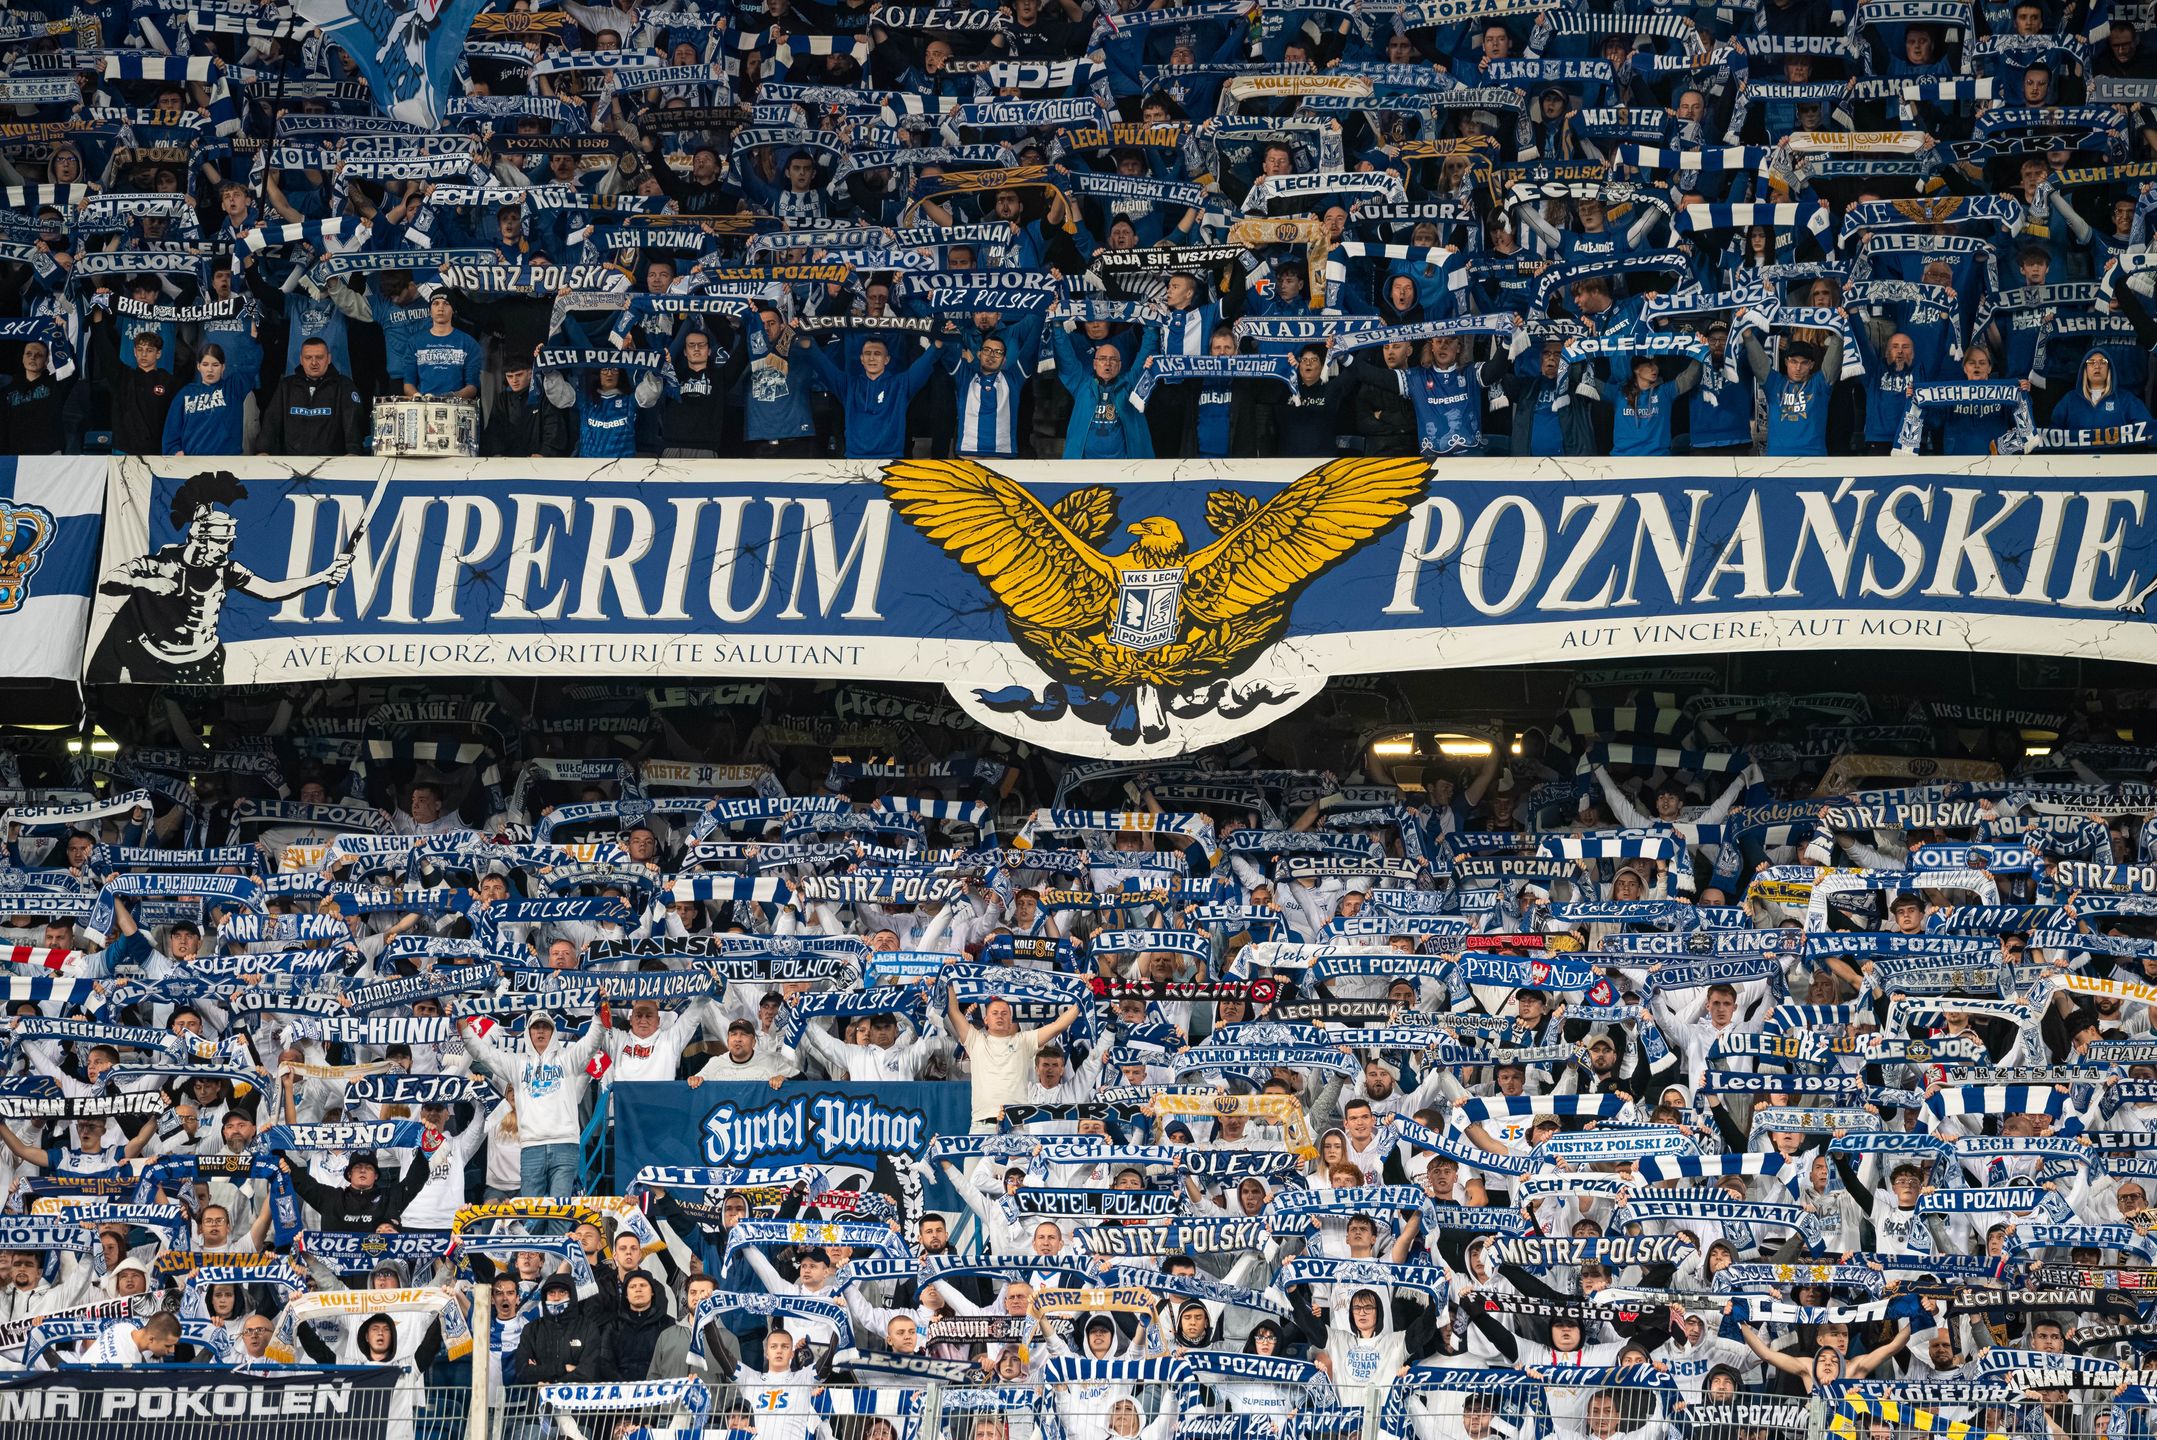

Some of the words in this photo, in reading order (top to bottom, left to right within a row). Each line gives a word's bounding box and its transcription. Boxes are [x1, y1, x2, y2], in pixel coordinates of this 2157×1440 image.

[1746, 34, 1850, 56] KOLEJORZ
[552, 48, 645, 67] LECH
[620, 66, 710, 86] BUŁGARSKA
[2102, 84, 2148, 98] LECH
[1583, 107, 1663, 126] MAJSTER
[1980, 107, 2031, 126] LECH
[1951, 133, 2089, 159] PYRY
[1555, 166, 1604, 181] POLSKI
[1275, 175, 1321, 192] LECH
[1353, 203, 1471, 220] KOLEJORZ
[1842, 205, 1891, 231] AVE
[1968, 197, 2021, 220] KKS
[606, 230, 640, 250] LECH
[77, 253, 198, 273] KOLEJORZ
[1104, 254, 1142, 267] BOJĄ
[1147, 253, 1171, 266] SIĘ
[1178, 248, 1246, 263] WSZYSCY
[1567, 260, 1618, 278] JEST
[1624, 254, 1687, 269] SUPER
[440, 266, 521, 290] MISTRZ
[531, 265, 607, 289] POLSKI
[719, 267, 764, 280] LECH
[908, 272, 1055, 292] KOLEJORZ
[652, 298, 749, 317] KOLEJORZ
[974, 290, 1043, 308] POLSKI
[800, 316, 845, 331] LECH
[1567, 336, 1702, 357] KOLEJORZ
[536, 350, 578, 367] LECH
[1156, 358, 1185, 372] KKS
[1190, 358, 1222, 370] Lech
[1228, 357, 1278, 372] Poznań
[1428, 393, 1470, 404] SUPERBET
[587, 418, 629, 428] SUPERBET
[1382, 479, 2148, 615] POZNAŃSKIE
[269, 494, 893, 623] IMPERIUM
[1127, 573, 1147, 583] KKS
[1153, 572, 1178, 583] LECH
[1122, 629, 1167, 643] POZNAŃ
[1561, 628, 1621, 648] AUT
[1633, 620, 1769, 644] VINCERE,
[1788, 618, 1850, 637] AUT
[1861, 618, 1942, 636] MORI
[282, 646, 332, 670] AVE
[345, 643, 495, 668] KOLEJORZ,
[507, 644, 658, 662] MORITURI
[671, 644, 703, 662] TE
[714, 644, 865, 664] SALUTANT
[8, 804, 49, 818] LECH
[53, 802, 92, 816] JEST
[98, 790, 151, 809] SUPER
[720, 800, 761, 819] LECH
[1896, 803, 1973, 827] POLSKI
[210, 847, 246, 861] LECH
[339, 839, 369, 854] KKS
[374, 836, 409, 853] LECH
[1289, 858, 1421, 872] CHICKEN
[1455, 859, 1494, 878] LECH
[145, 876, 154, 889] Z
[157, 875, 237, 892] POCHODZENIA
[802, 877, 883, 900] MISTRZ
[1139, 877, 1212, 892] MAJSTER
[358, 889, 441, 906] MAJSTER
[1100, 892, 1115, 905] 10
[517, 900, 591, 918] POLSKI
[1623, 935, 1683, 954] LECH
[1718, 932, 1777, 951] KING
[1811, 937, 1877, 955] LECH
[289, 950, 336, 973] PANY
[1272, 944, 1309, 964] Lech
[772, 957, 840, 979] PÓŁNOC
[1318, 959, 1362, 976] LECH
[640, 977, 661, 997] DLA
[2066, 975, 2113, 992] LECH
[454, 990, 598, 1015] KOLEJORZ
[1277, 1004, 1321, 1019] LECH
[23, 1020, 53, 1033] KKS
[59, 1022, 96, 1037] LECH
[1447, 1016, 1508, 1030] HOOLIGANS
[1185, 1050, 1234, 1064] TYLKO
[1240, 1050, 1279, 1063] LECH
[1442, 1047, 1489, 1061] ONLY
[1713, 1075, 1783, 1090] Lech
[1793, 1075, 1857, 1093] 1922
[74, 1092, 163, 1115] FANATICS
[705, 1100, 803, 1163] Fyrtel
[815, 1098, 922, 1152] Północ
[1403, 1121, 1429, 1141] KKS
[1435, 1136, 1472, 1158] LECH
[1500, 1125, 1523, 1140] STS
[1546, 1140, 1603, 1154] MISTRZ
[1607, 1138, 1661, 1152] POLSKI
[1967, 1139, 2014, 1152] LECH
[1019, 1191, 1096, 1214] FYRTEL
[1102, 1189, 1177, 1214] PÓŁNOC
[1963, 1188, 2035, 1208] POZNAŃ
[74, 1205, 110, 1219] LECH
[1635, 1202, 1694, 1217] LECH
[743, 1222, 788, 1239] LECH
[842, 1222, 887, 1242] KING
[1084, 1229, 1166, 1254] MISTRZ
[1178, 1223, 1263, 1252] POLSKI
[1500, 1239, 1580, 1264] MISTRZ
[1596, 1238, 1676, 1263] POLSKI
[937, 1255, 996, 1269] LECH
[1954, 1291, 2001, 1307] LECH
[2073, 1326, 2120, 1344] LECH
[1352, 1369, 1371, 1378] 1922
[101, 1379, 353, 1418] POKOLEŃ
[546, 1385, 622, 1400] FORZA
[633, 1381, 687, 1398] LECH
[757, 1391, 789, 1410] STS
[1242, 1397, 1285, 1406] SUPERBET
